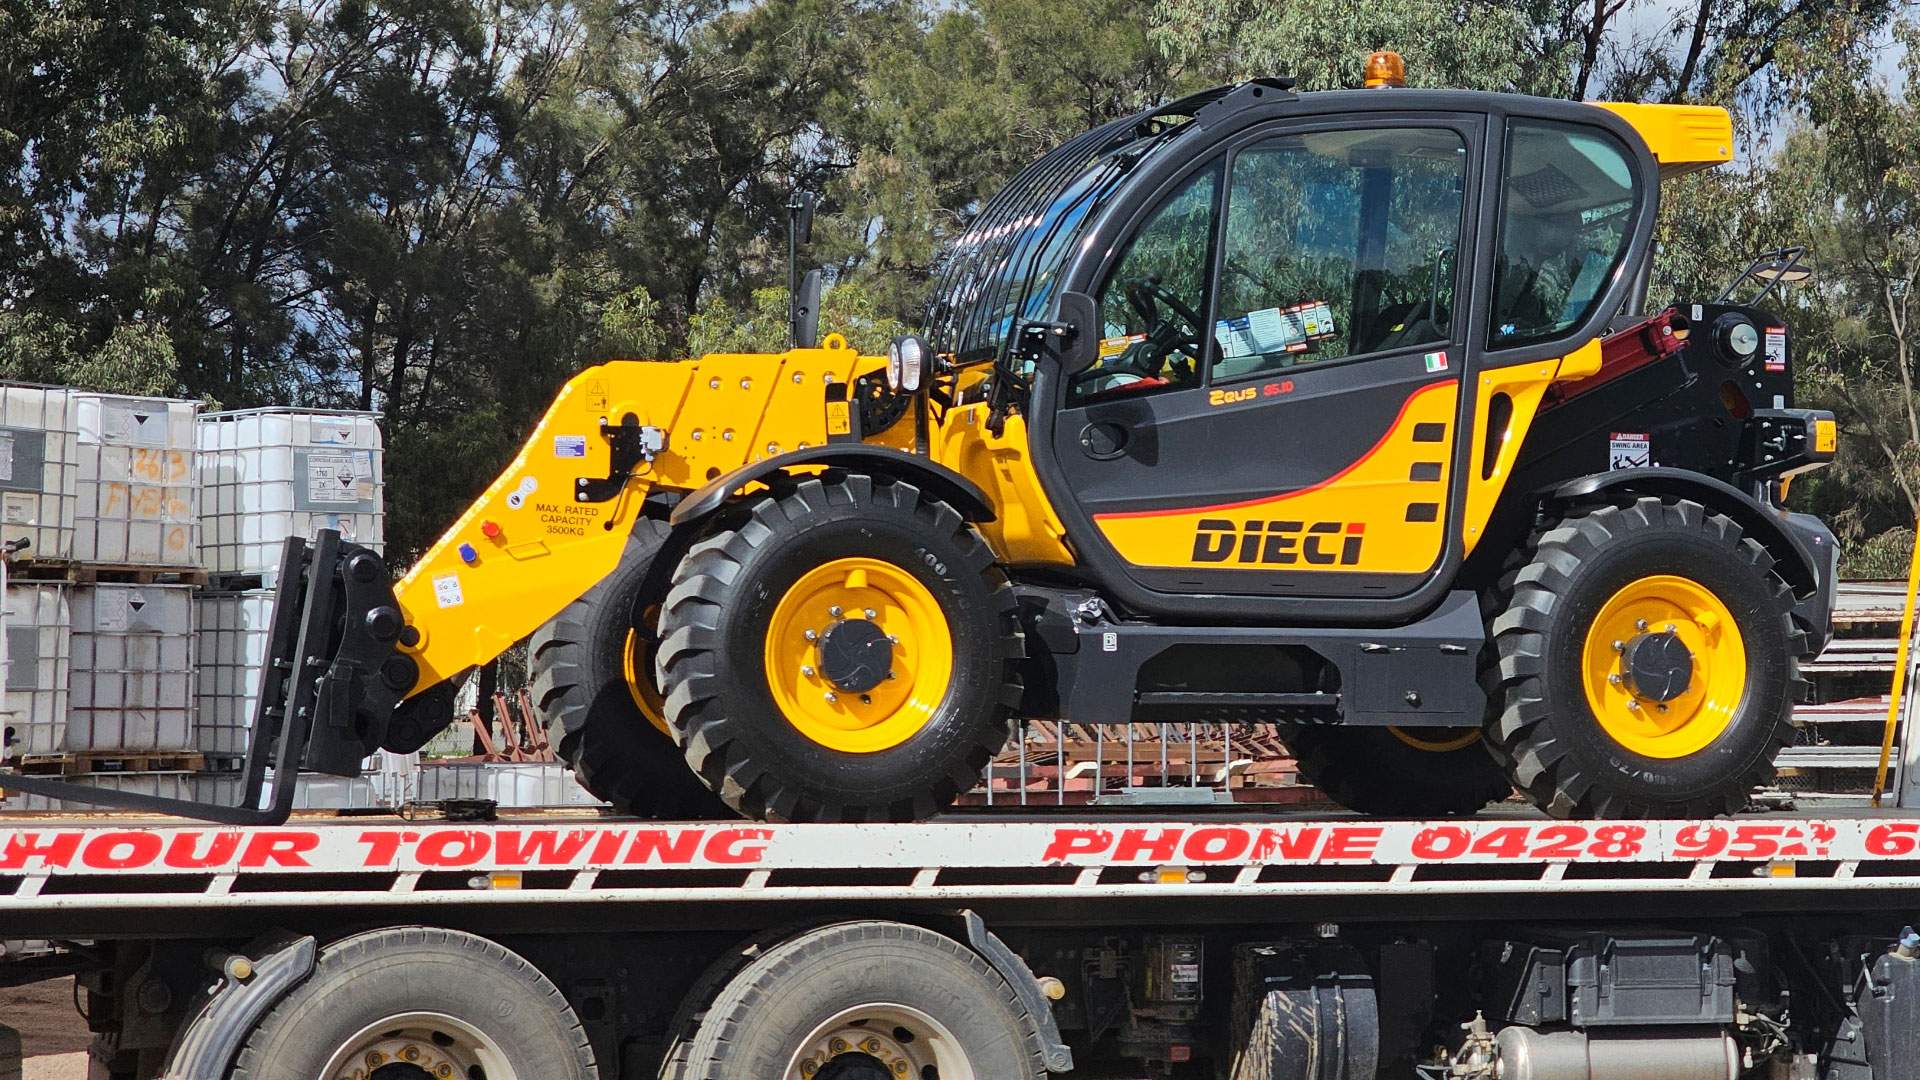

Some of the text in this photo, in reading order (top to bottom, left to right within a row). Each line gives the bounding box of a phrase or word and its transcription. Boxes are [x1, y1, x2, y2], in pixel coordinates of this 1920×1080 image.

[535, 503, 599, 516] MAX. RATED
[540, 514, 592, 527] CAPACITY
[546, 525, 584, 536] 3500KG
[0, 828, 773, 868] HOUR TOWING
[1041, 827, 1383, 861] PHONE
[1410, 825, 1646, 859] 0428
[1673, 824, 1837, 858] 952
